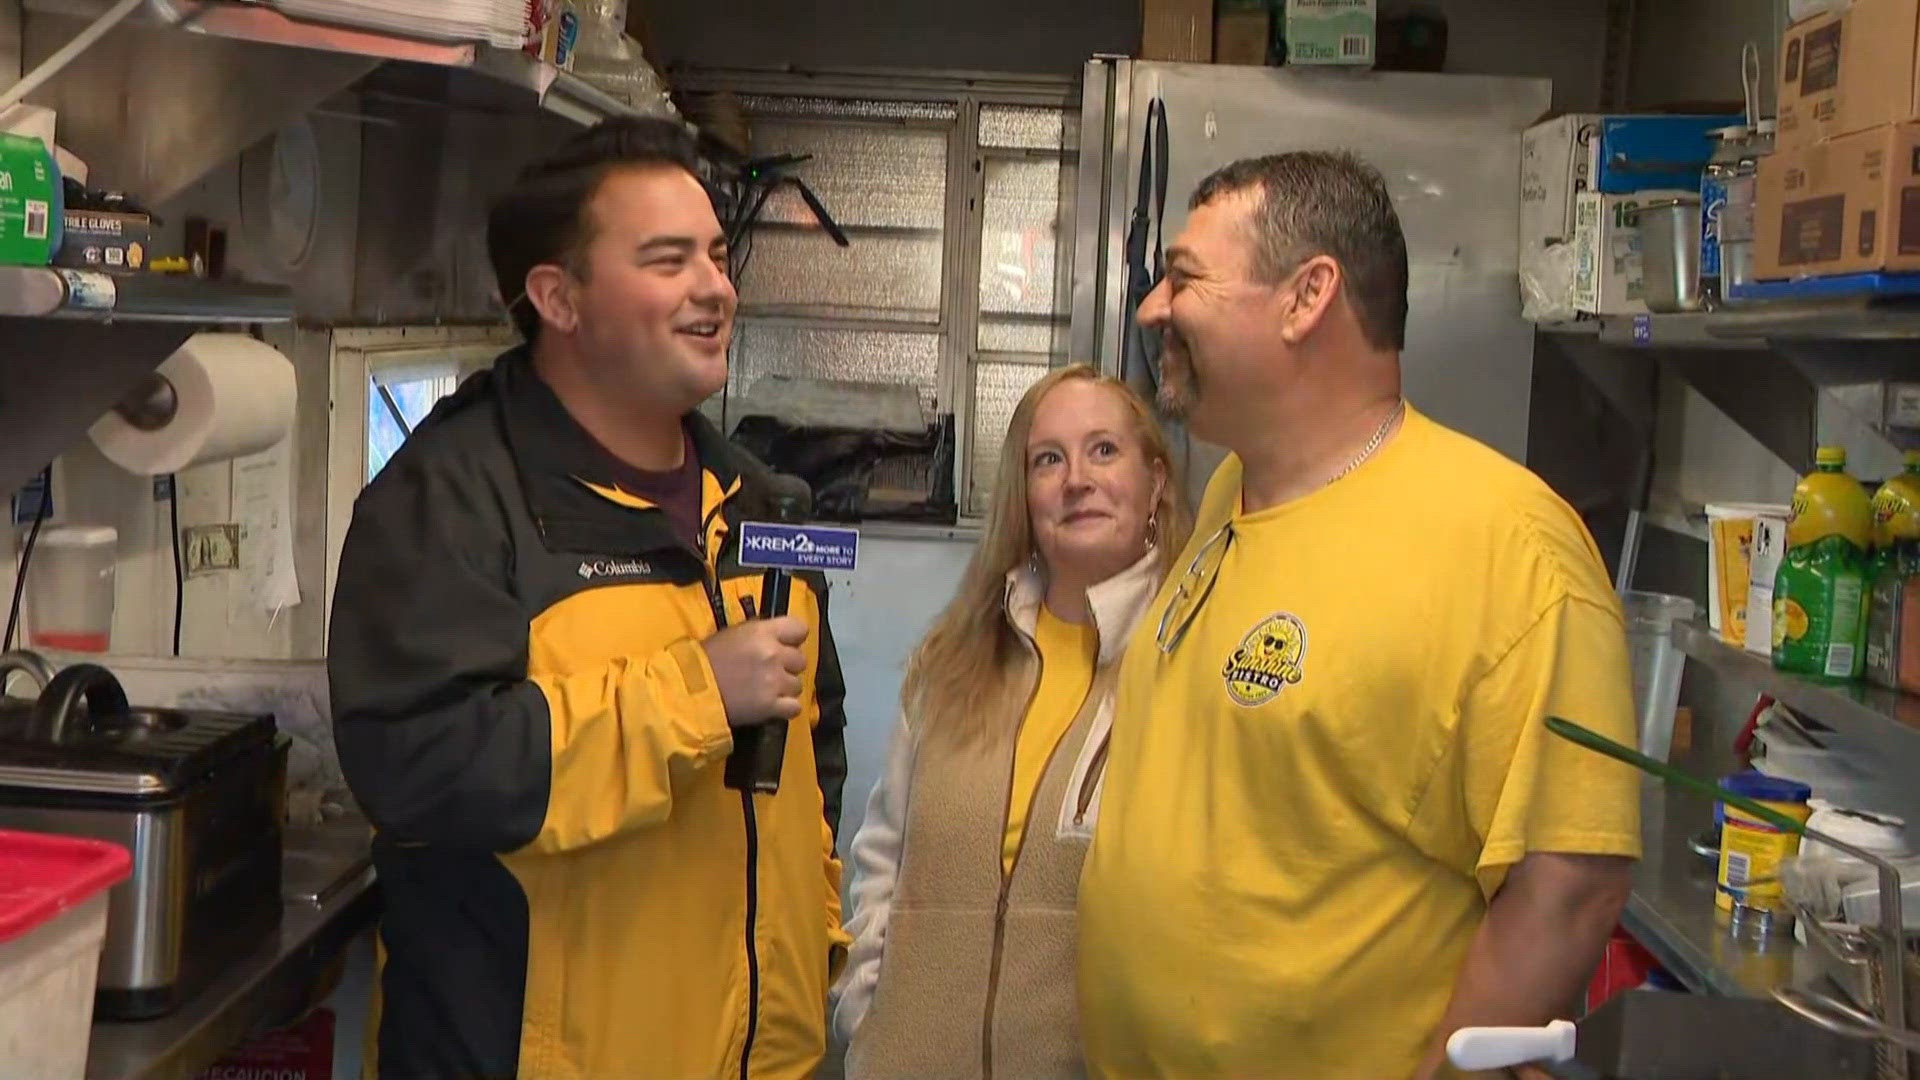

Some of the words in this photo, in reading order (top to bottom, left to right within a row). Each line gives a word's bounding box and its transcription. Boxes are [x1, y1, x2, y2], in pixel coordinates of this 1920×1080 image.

[89, 218, 122, 230] GLOVES
[815, 544, 840, 556] MORE
[842, 546, 854, 556] TO
[797, 554, 825, 564] EVERY
[826, 556, 853, 566] STORY
[594, 560, 652, 576] Columbia
[1231, 668, 1279, 689] BISTRO
